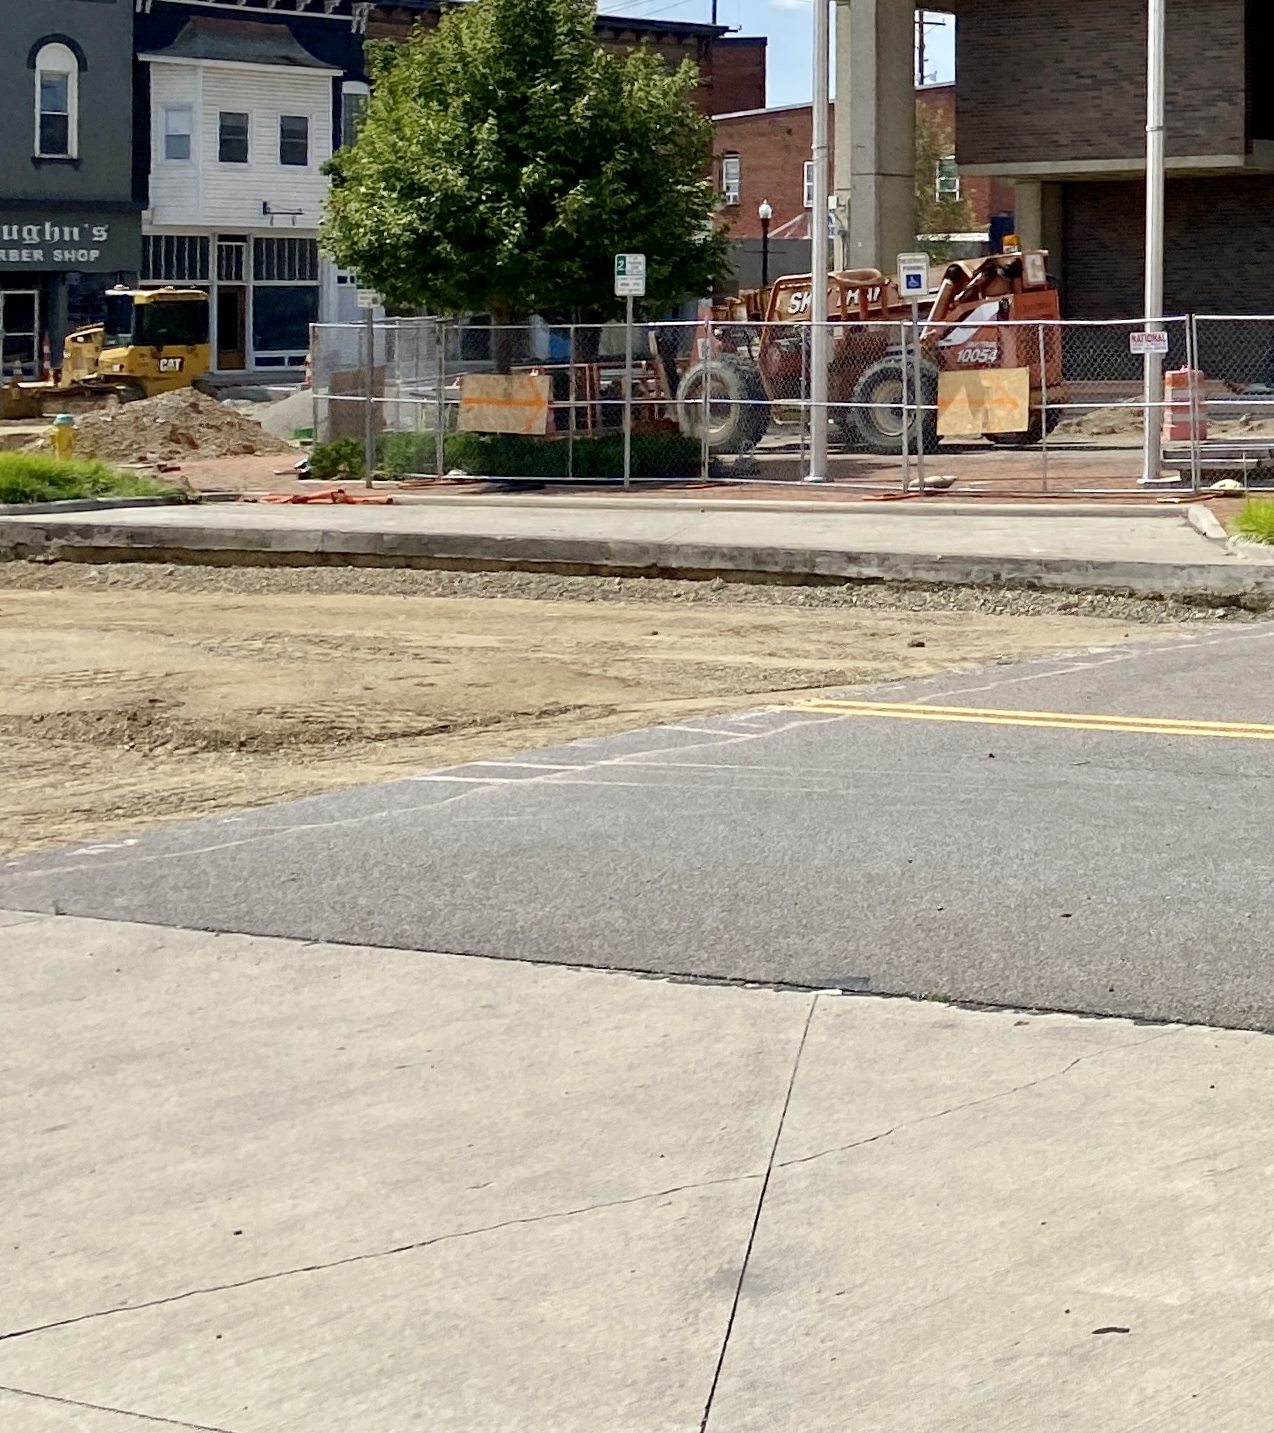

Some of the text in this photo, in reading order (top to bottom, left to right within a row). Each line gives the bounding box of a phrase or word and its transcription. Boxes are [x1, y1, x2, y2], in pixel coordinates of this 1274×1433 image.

[53, 249, 100, 261] SHOP
[1131, 333, 1166, 343] NATIONAL
[957, 348, 998, 363] 10054
[160, 358, 181, 371] CAT
